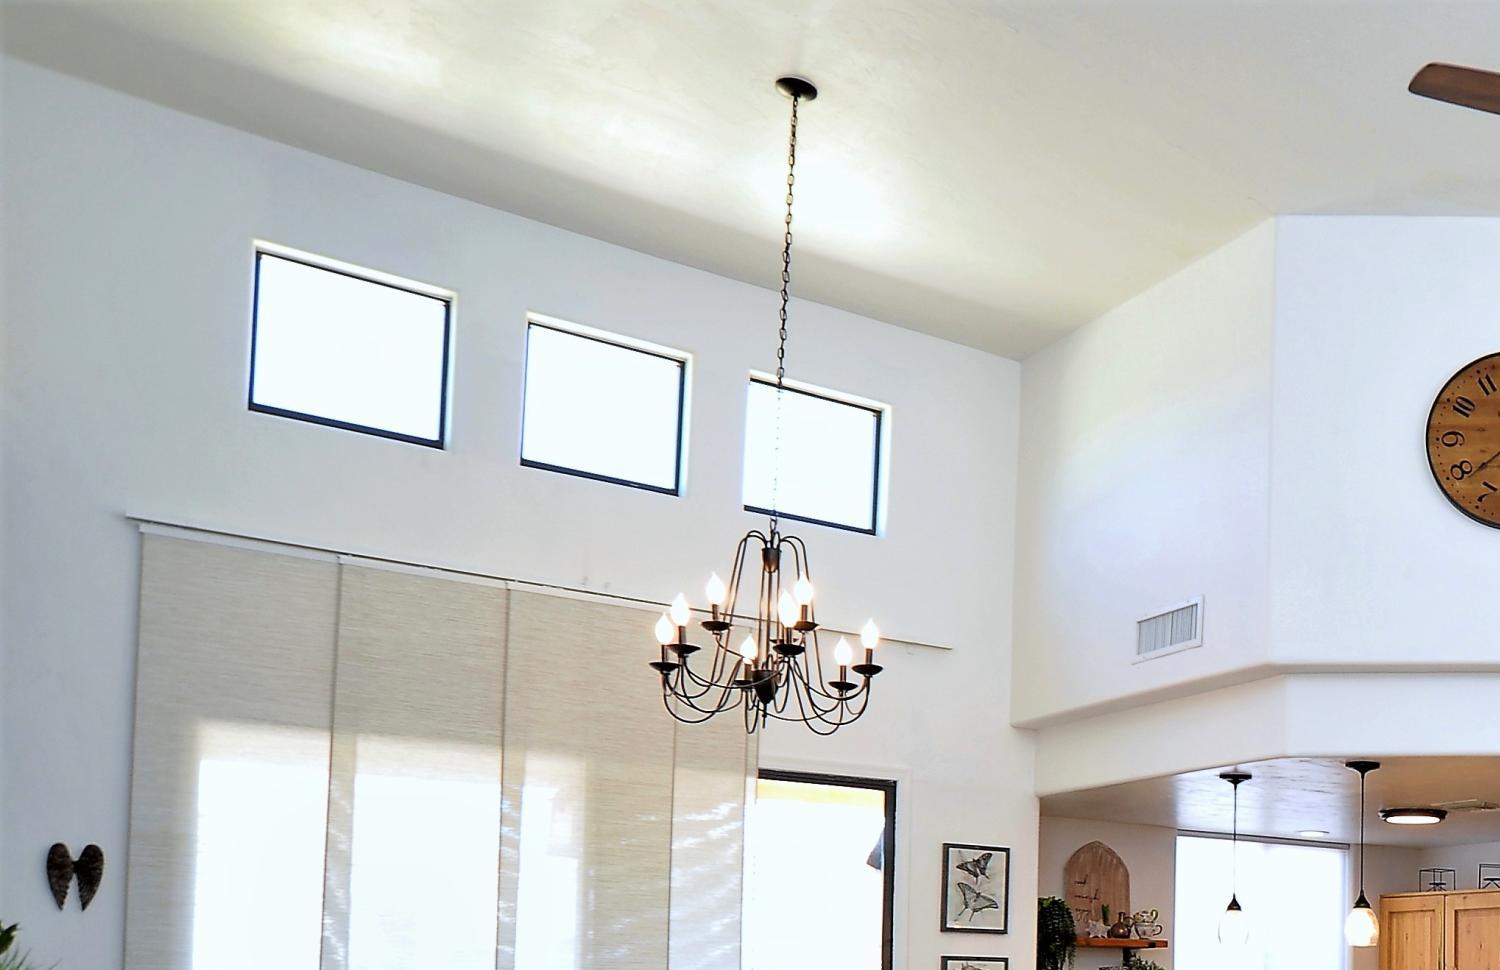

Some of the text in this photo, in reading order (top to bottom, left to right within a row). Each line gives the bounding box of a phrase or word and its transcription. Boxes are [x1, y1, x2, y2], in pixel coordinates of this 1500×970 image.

[1477, 374, 1497, 396] 11
[1452, 396, 1476, 418] 10
[1441, 431, 1465, 447] 9
[1450, 460, 1472, 480] 8
[1477, 482, 1498, 503] 7
